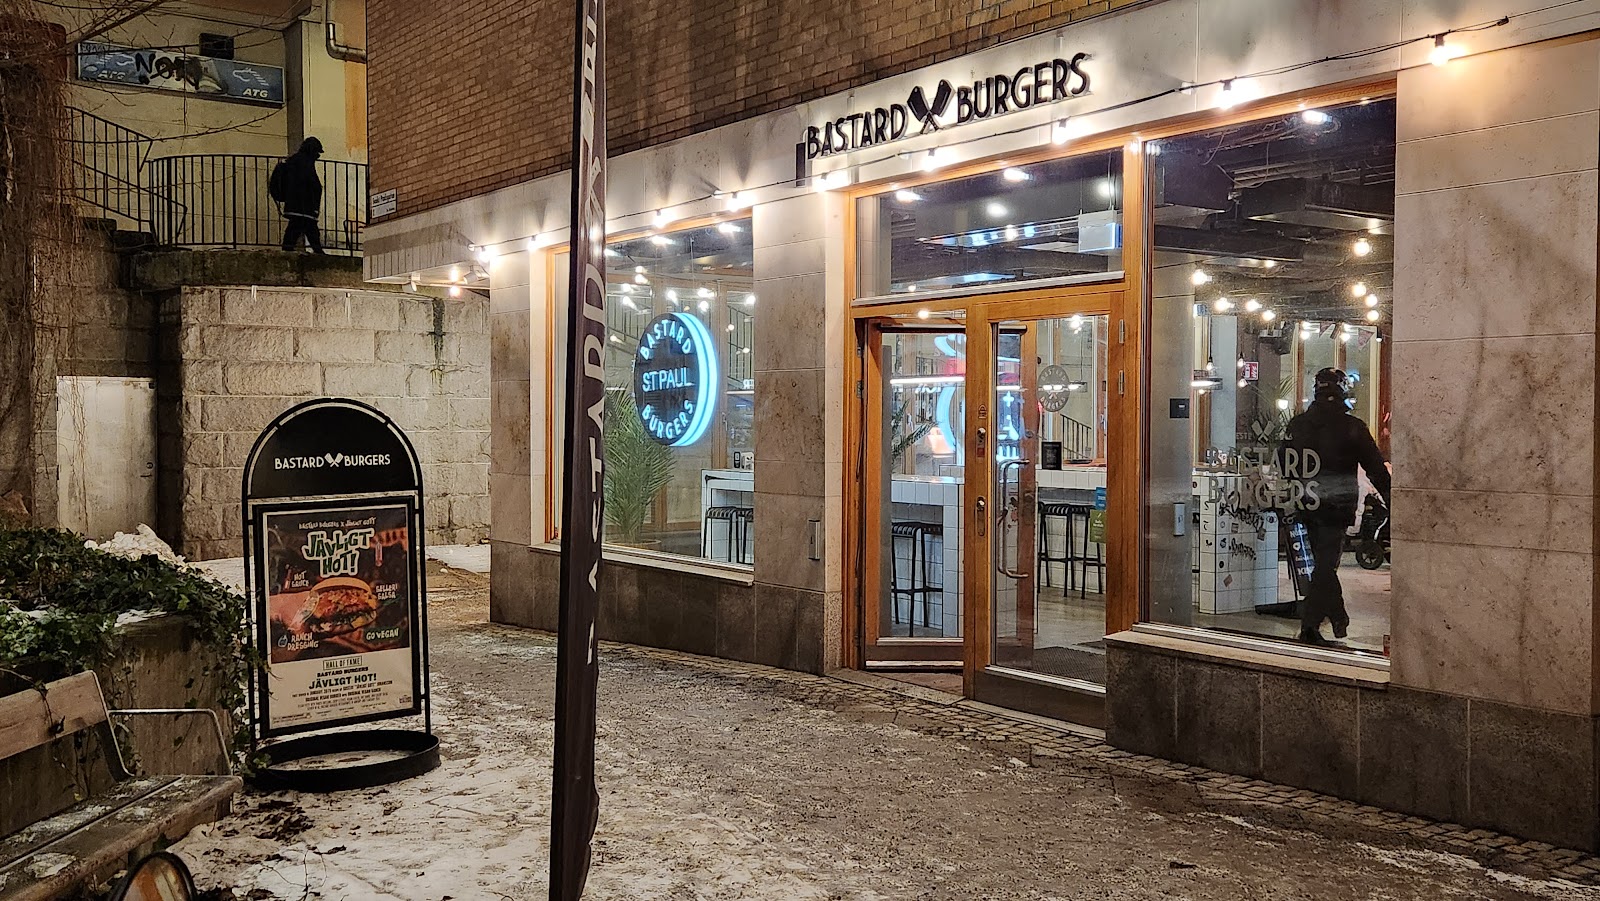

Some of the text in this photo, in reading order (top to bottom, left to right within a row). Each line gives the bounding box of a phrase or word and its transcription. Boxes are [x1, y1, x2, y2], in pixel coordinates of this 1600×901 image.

[243, 88, 268, 98] ATG
[806, 52, 1094, 160] BASTARD BURGERS
[640, 319, 692, 360] BASTARD
[642, 400, 693, 439] BURGERS
[274, 454, 391, 470] BASTARD BURGERS
[1206, 447, 1321, 479] BASTARD
[1209, 476, 1321, 511] BURGERS
[303, 529, 373, 559] JÄVLIGT
[321, 551, 358, 576] HOT!
[294, 570, 307, 580] HOT
[377, 591, 396, 600] SALSA
[291, 632, 313, 643] RANCH
[366, 627, 399, 640] GO VEGAN
[287, 640, 319, 651] DRESSING
[325, 657, 361, 669] HALL OF FAME
[316, 666, 369, 678] BASTARD BURGERS
[308, 676, 352, 690] JÄVLIGT
[354, 673, 377, 684] HOT!
